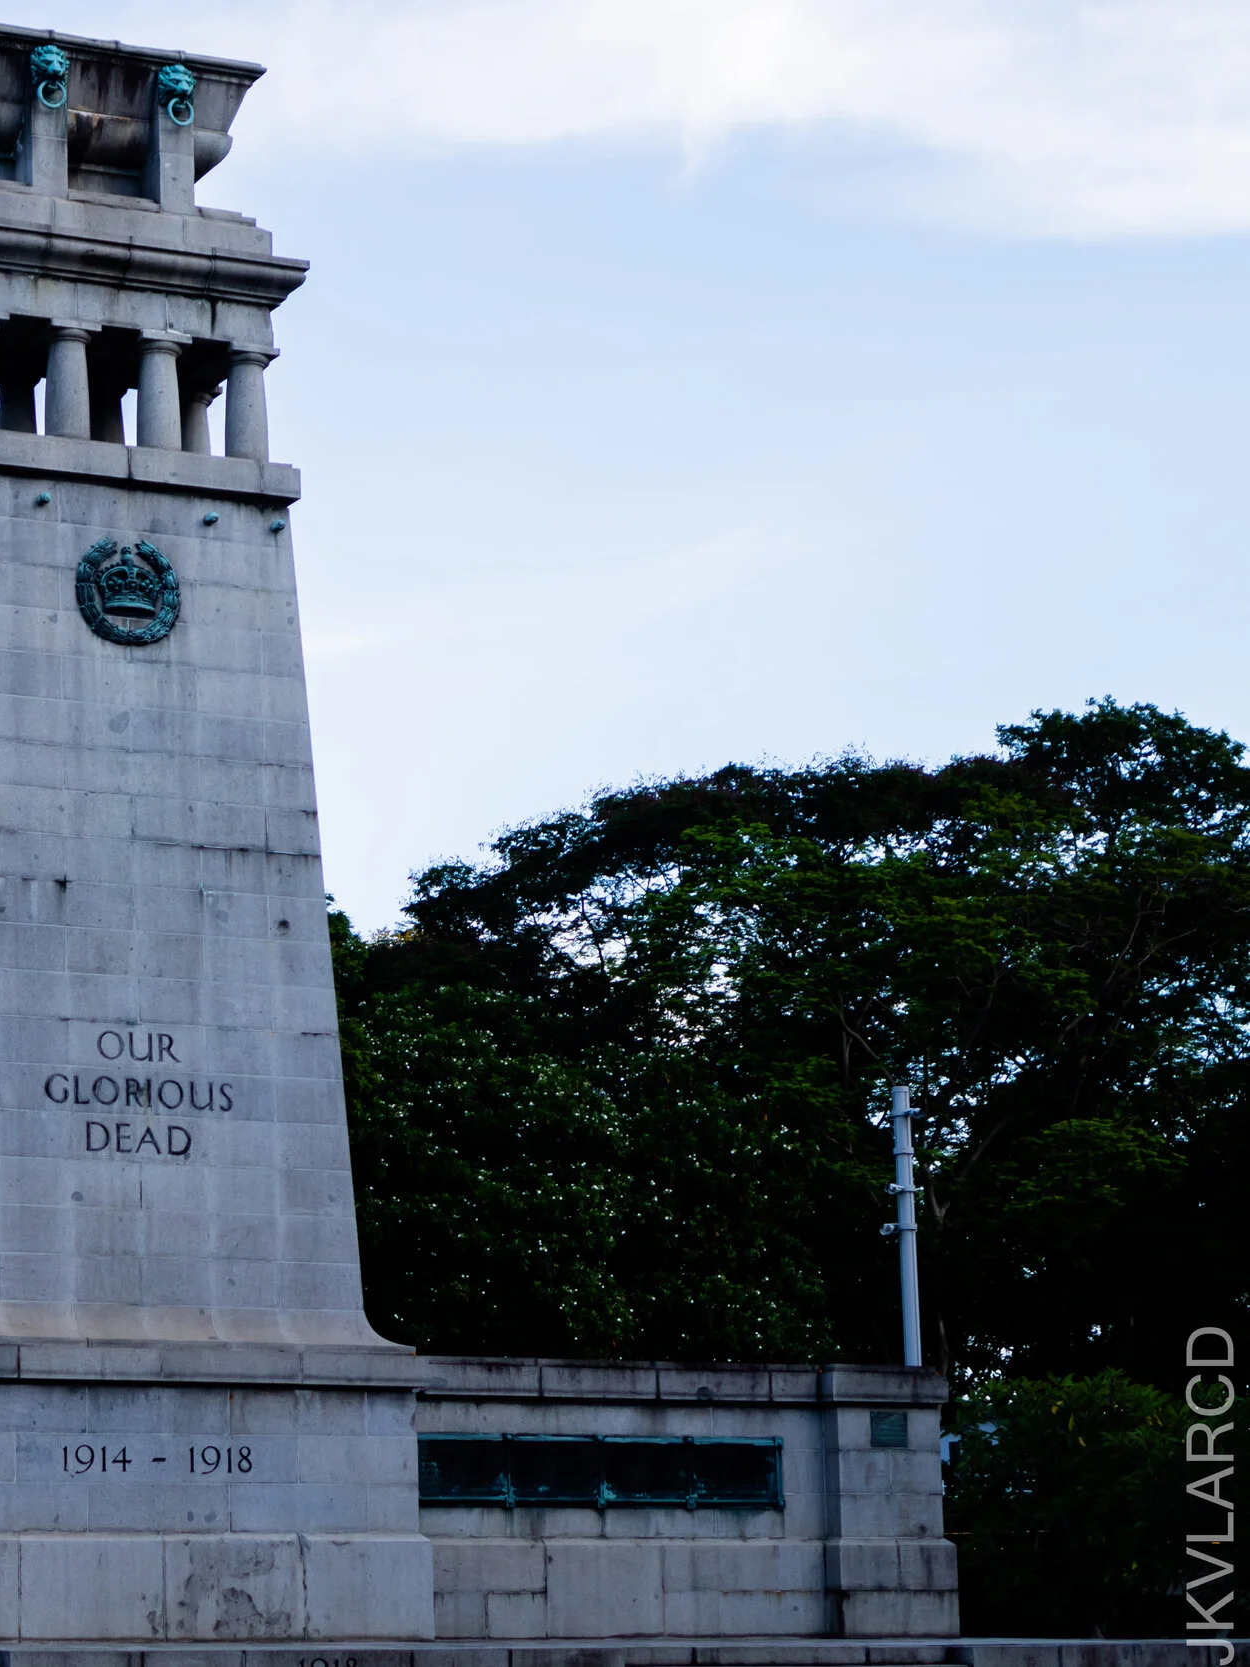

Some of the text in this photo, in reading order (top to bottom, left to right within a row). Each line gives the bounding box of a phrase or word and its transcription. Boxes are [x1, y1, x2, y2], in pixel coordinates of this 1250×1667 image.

[97, 1030, 181, 1063] OUR
[44, 1073, 234, 1112] GLORIOUS
[85, 1121, 192, 1156] DEAD
[62, 1445, 132, 1475] 1914
[188, 1445, 253, 1475] 1918
